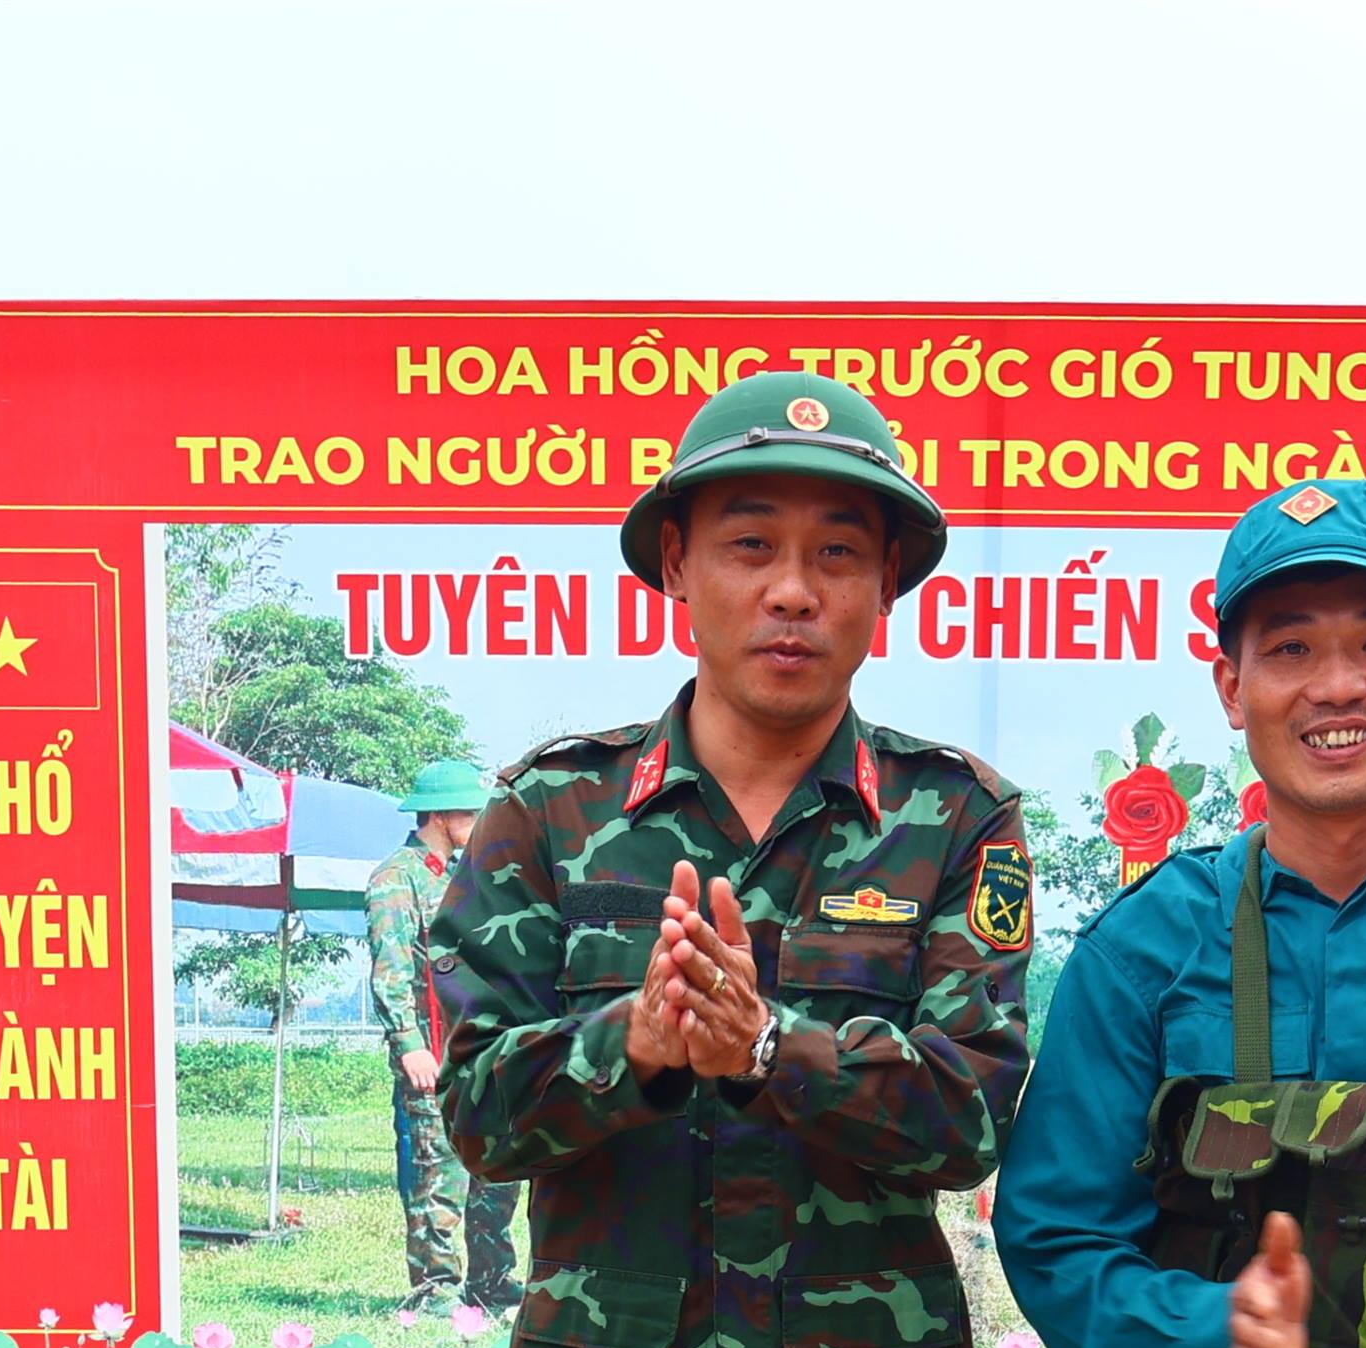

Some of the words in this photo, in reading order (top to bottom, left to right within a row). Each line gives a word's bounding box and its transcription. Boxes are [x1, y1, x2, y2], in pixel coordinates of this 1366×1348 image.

[396, 346, 548, 396] HOA
[1050, 336, 1173, 399] GIÓ
[175, 436, 365, 486] TRAO
[387, 424, 606, 486] NGƯỜI
[959, 439, 1200, 491] TRONG
[337, 556, 587, 656] TUYÊN
[919, 550, 1158, 660] CHIẾN
